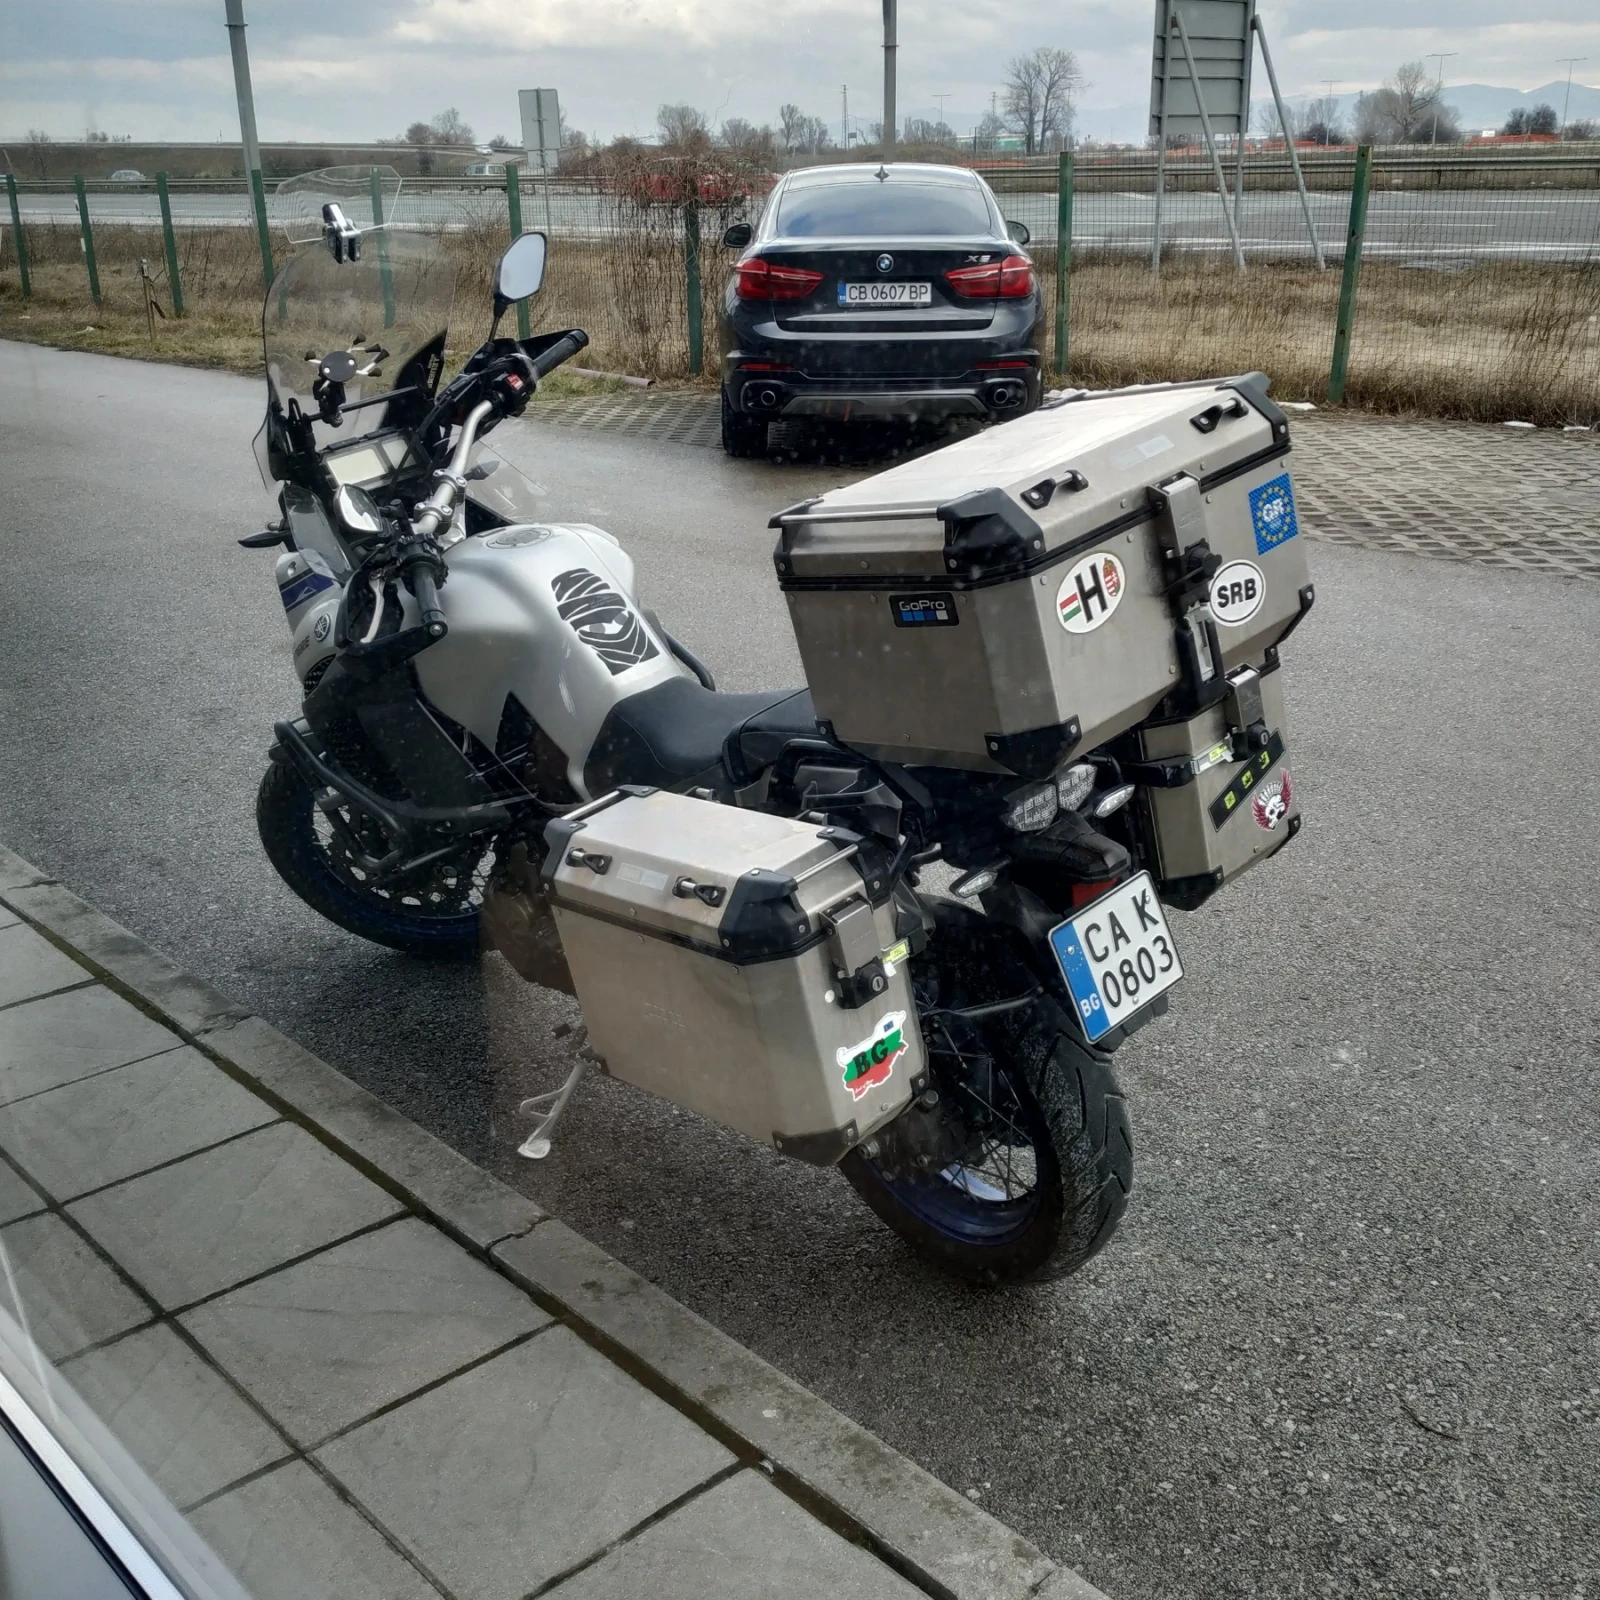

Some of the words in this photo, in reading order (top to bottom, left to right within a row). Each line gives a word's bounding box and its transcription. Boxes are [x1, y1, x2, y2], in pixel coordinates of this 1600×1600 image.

[848, 285, 868, 301] CB
[871, 285, 907, 300] 0607
[909, 285, 928, 300] BP
[1262, 498, 1285, 522] GR
[899, 599, 946, 611] GoPro
[1074, 562, 1108, 623] H
[1217, 578, 1257, 608] SRB
[1084, 910, 1131, 963] CA
[1131, 888, 1160, 932] K
[1102, 935, 1173, 1008] 0803
[1080, 993, 1101, 1018] BG
[852, 1038, 889, 1079] BG
